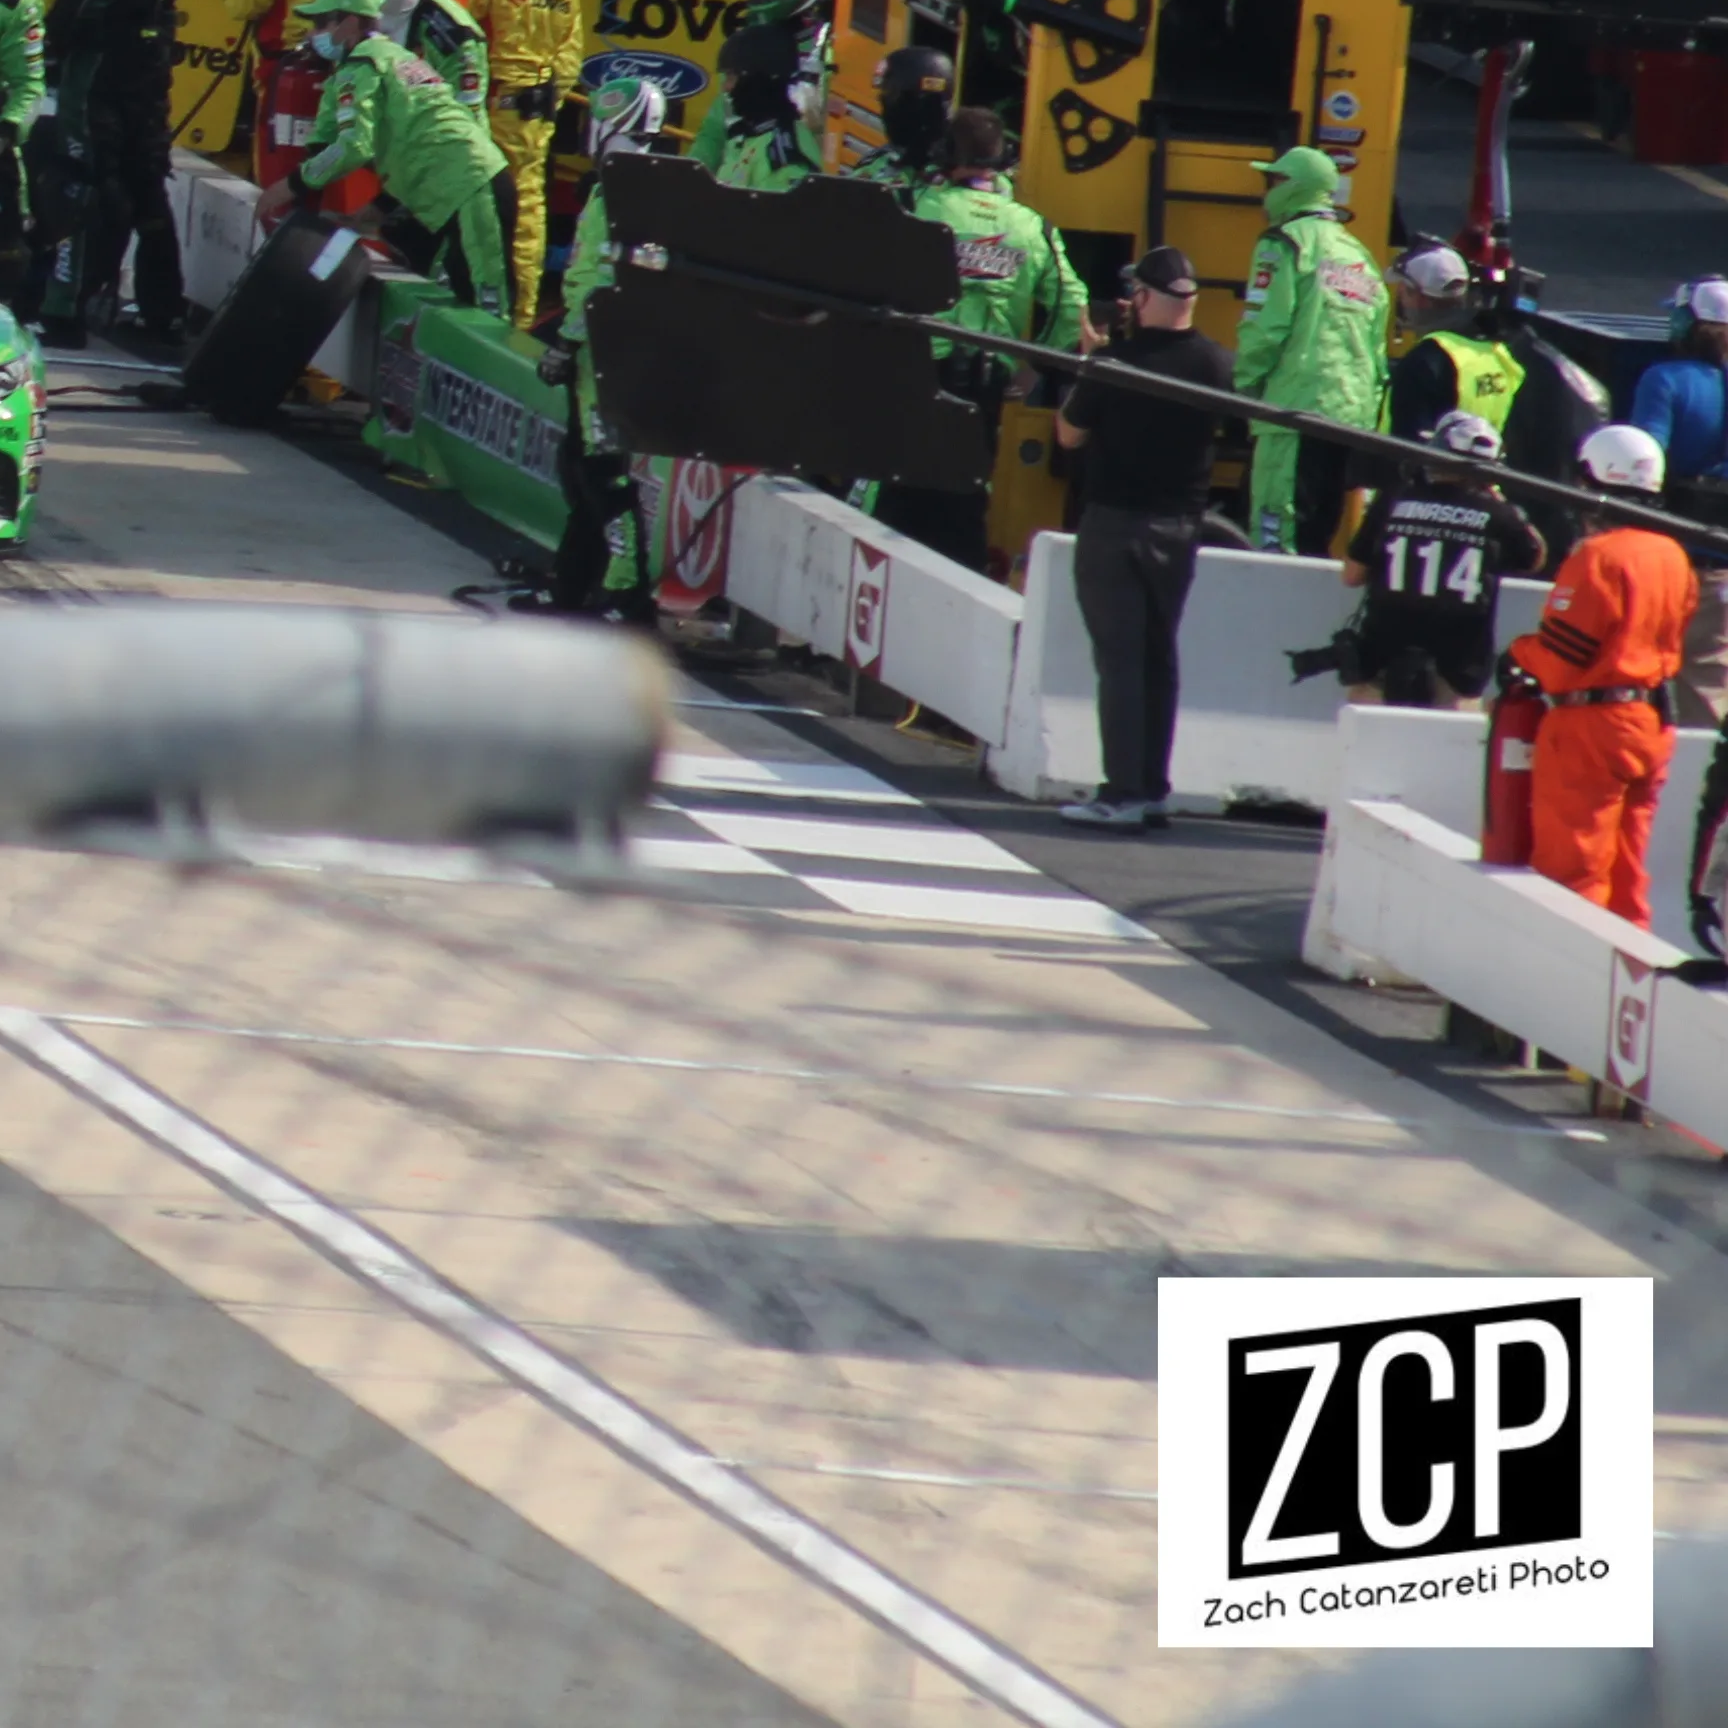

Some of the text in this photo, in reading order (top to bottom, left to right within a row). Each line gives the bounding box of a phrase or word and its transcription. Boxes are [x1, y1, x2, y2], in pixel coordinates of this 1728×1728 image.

[1409, 501, 1491, 529] NASCAR
[1385, 523, 1487, 547] PRODUCTIONS
[1385, 535, 1484, 604] 114
